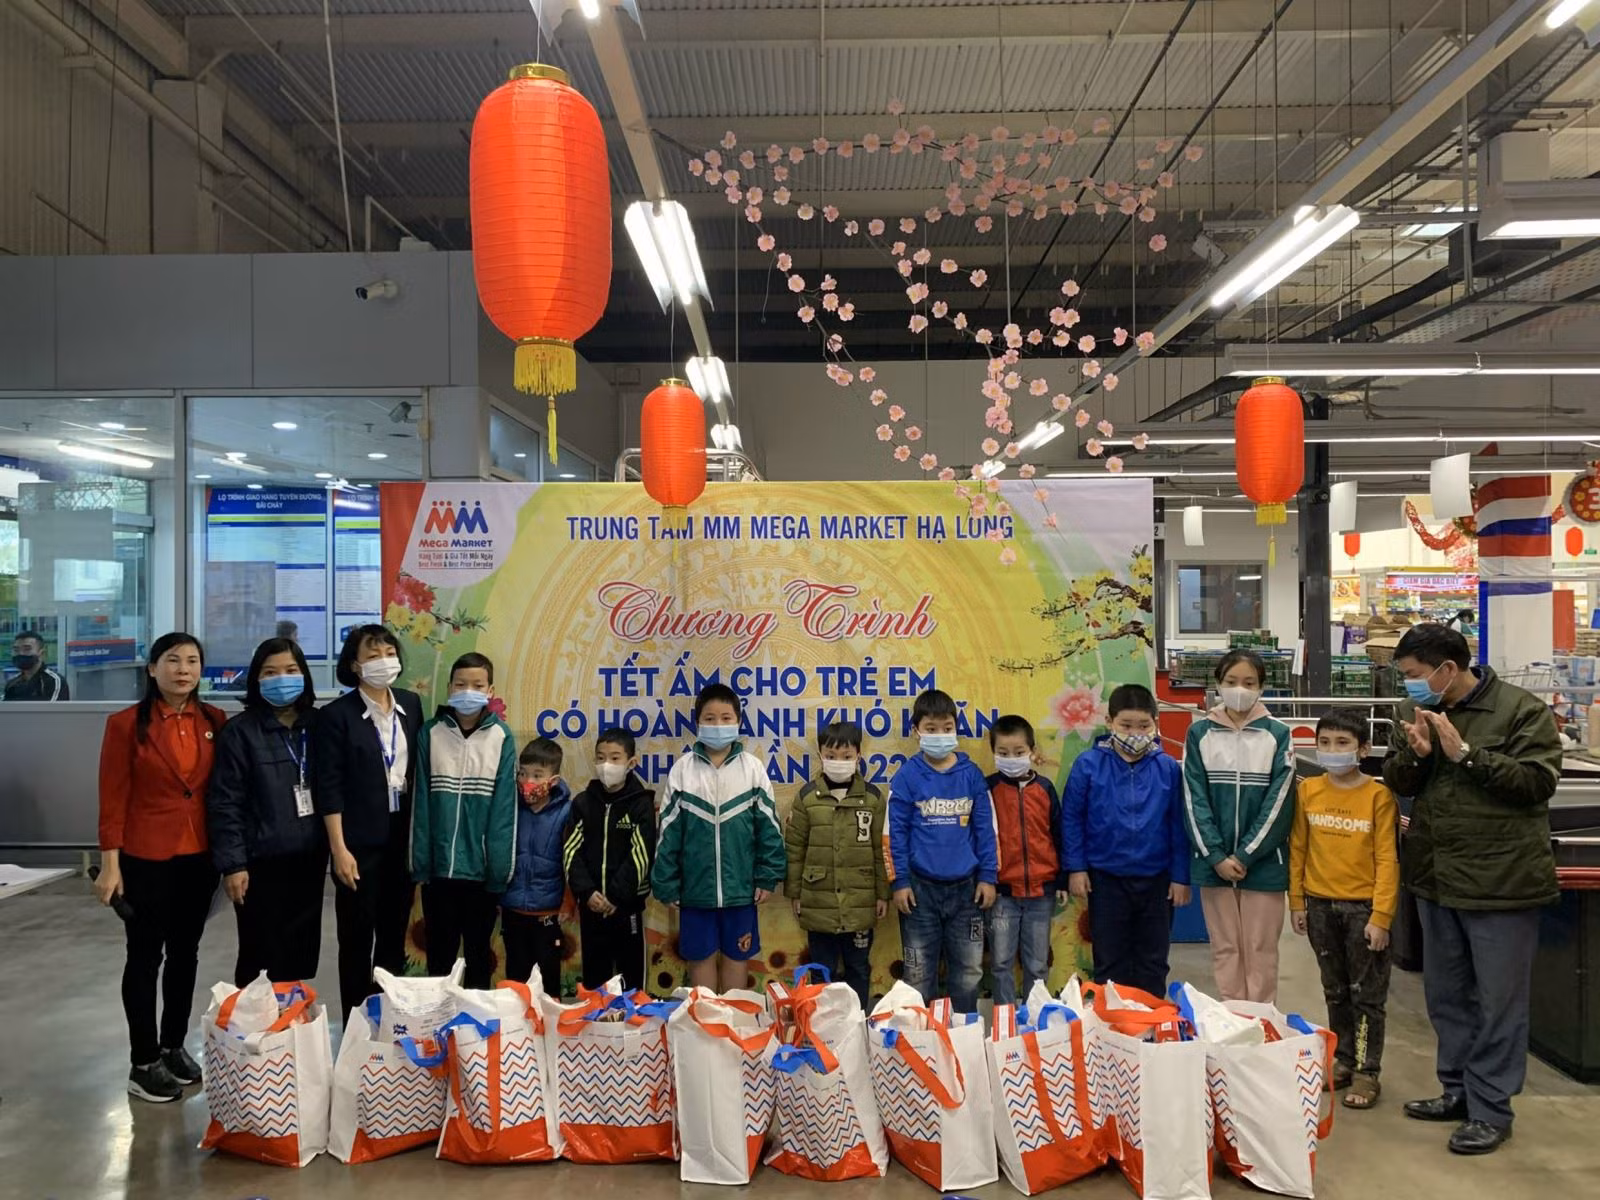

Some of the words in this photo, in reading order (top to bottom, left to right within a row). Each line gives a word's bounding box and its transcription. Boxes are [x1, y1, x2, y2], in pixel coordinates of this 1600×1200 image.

[566, 516, 638, 540] TRUNG
[704, 516, 740, 540] MM
[751, 516, 810, 540] MEGA
[820, 516, 908, 539] MARKET
[917, 515, 946, 543] HẠ
[598, 581, 776, 660] Chương
[783, 579, 936, 639] Trình
[598, 652, 660, 697] TẾT
[730, 665, 807, 697] CHO
[816, 656, 878, 697] TRẺ
[888, 667, 936, 697] EM
[536, 700, 588, 739] CÓ
[598, 699, 698, 738] HOÀN
[738, 698, 805, 738] ẢNH
[766, 739, 810, 784] ẦN
